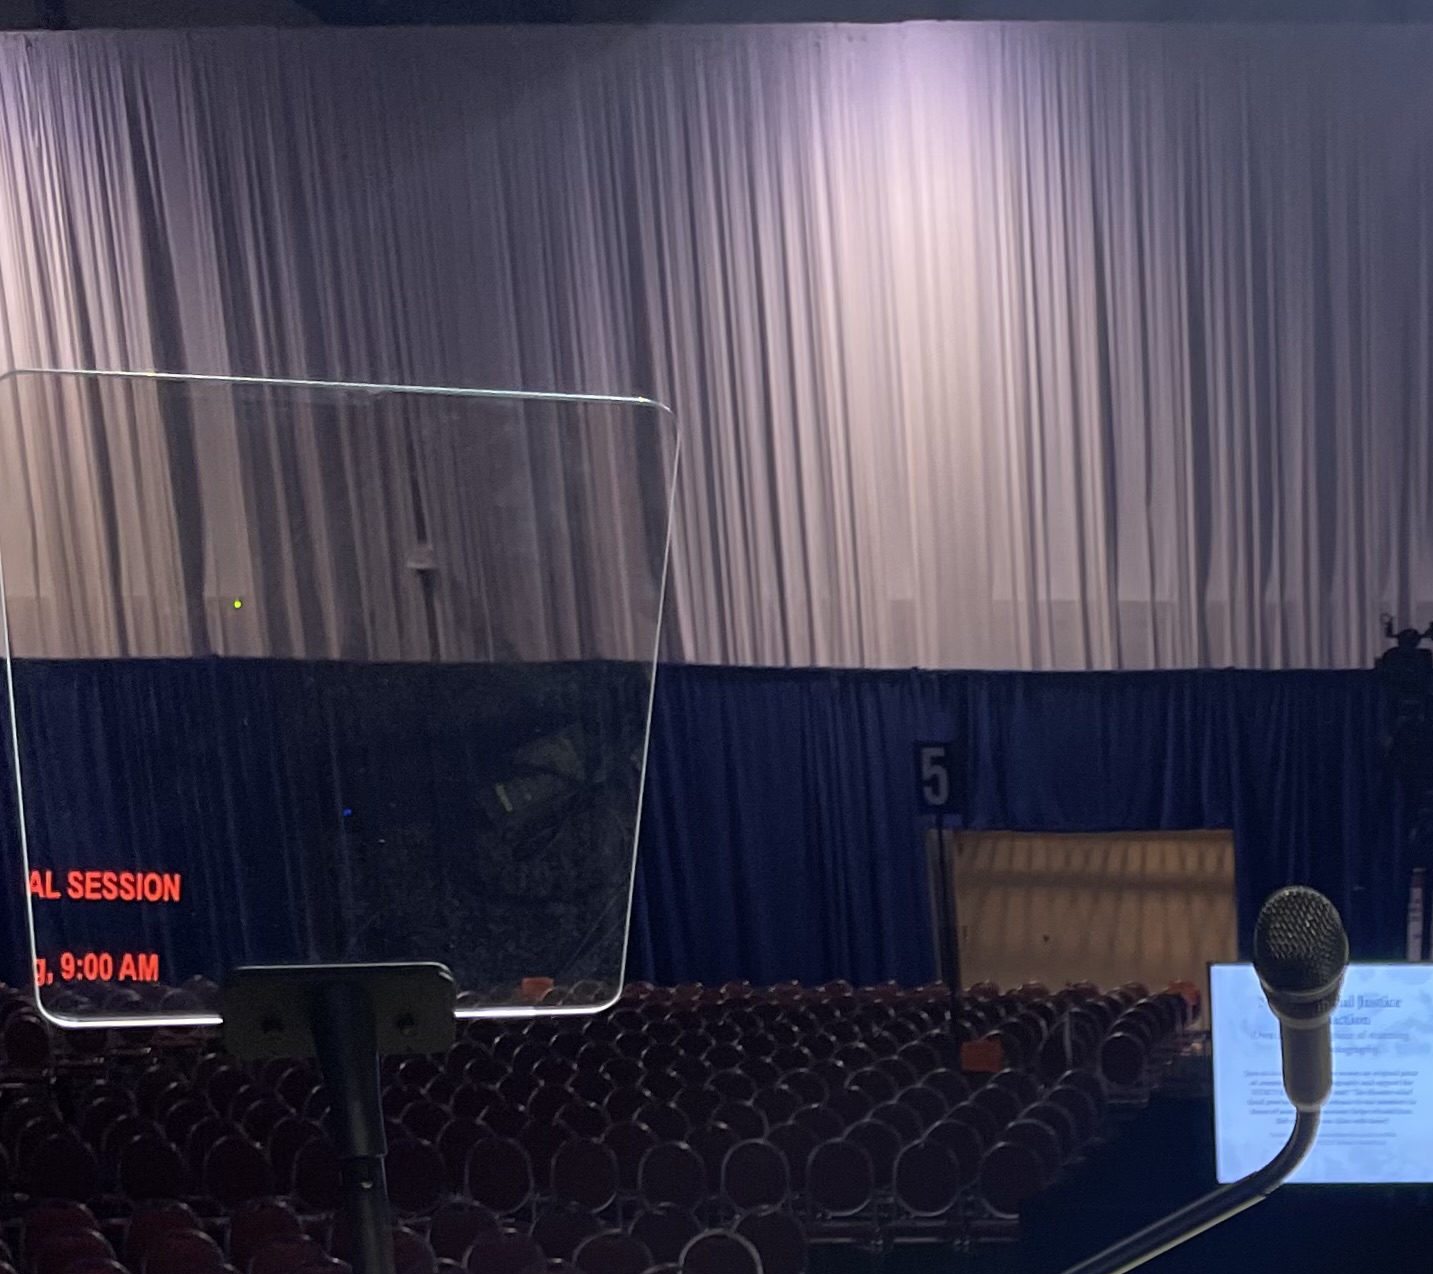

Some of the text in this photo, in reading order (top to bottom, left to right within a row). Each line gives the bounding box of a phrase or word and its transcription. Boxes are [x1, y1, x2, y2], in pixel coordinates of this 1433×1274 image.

[921, 747, 948, 804] 5
[67, 871, 181, 902] SESSION
[61, 952, 113, 981] 9:00
[119, 953, 159, 982] AM
